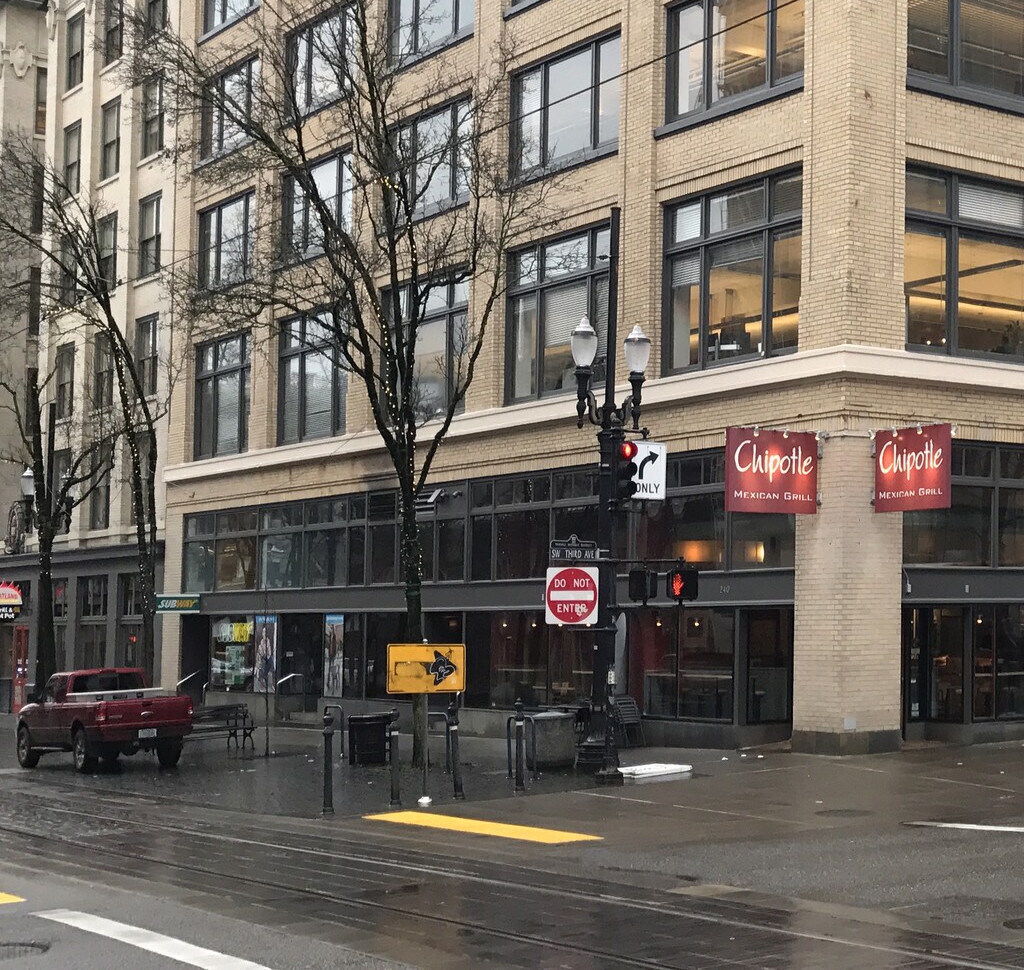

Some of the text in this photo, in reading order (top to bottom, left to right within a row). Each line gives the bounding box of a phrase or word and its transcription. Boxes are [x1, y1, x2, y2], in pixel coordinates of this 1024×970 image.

[734, 439, 814, 482] Chipotle
[879, 439, 943, 480] Chipotle
[636, 483, 660, 494] ONLY
[551, 549, 594, 558] SW THIRD AVE
[554, 579, 590, 587] DO NOT
[158, 599, 195, 609] SUBWAY
